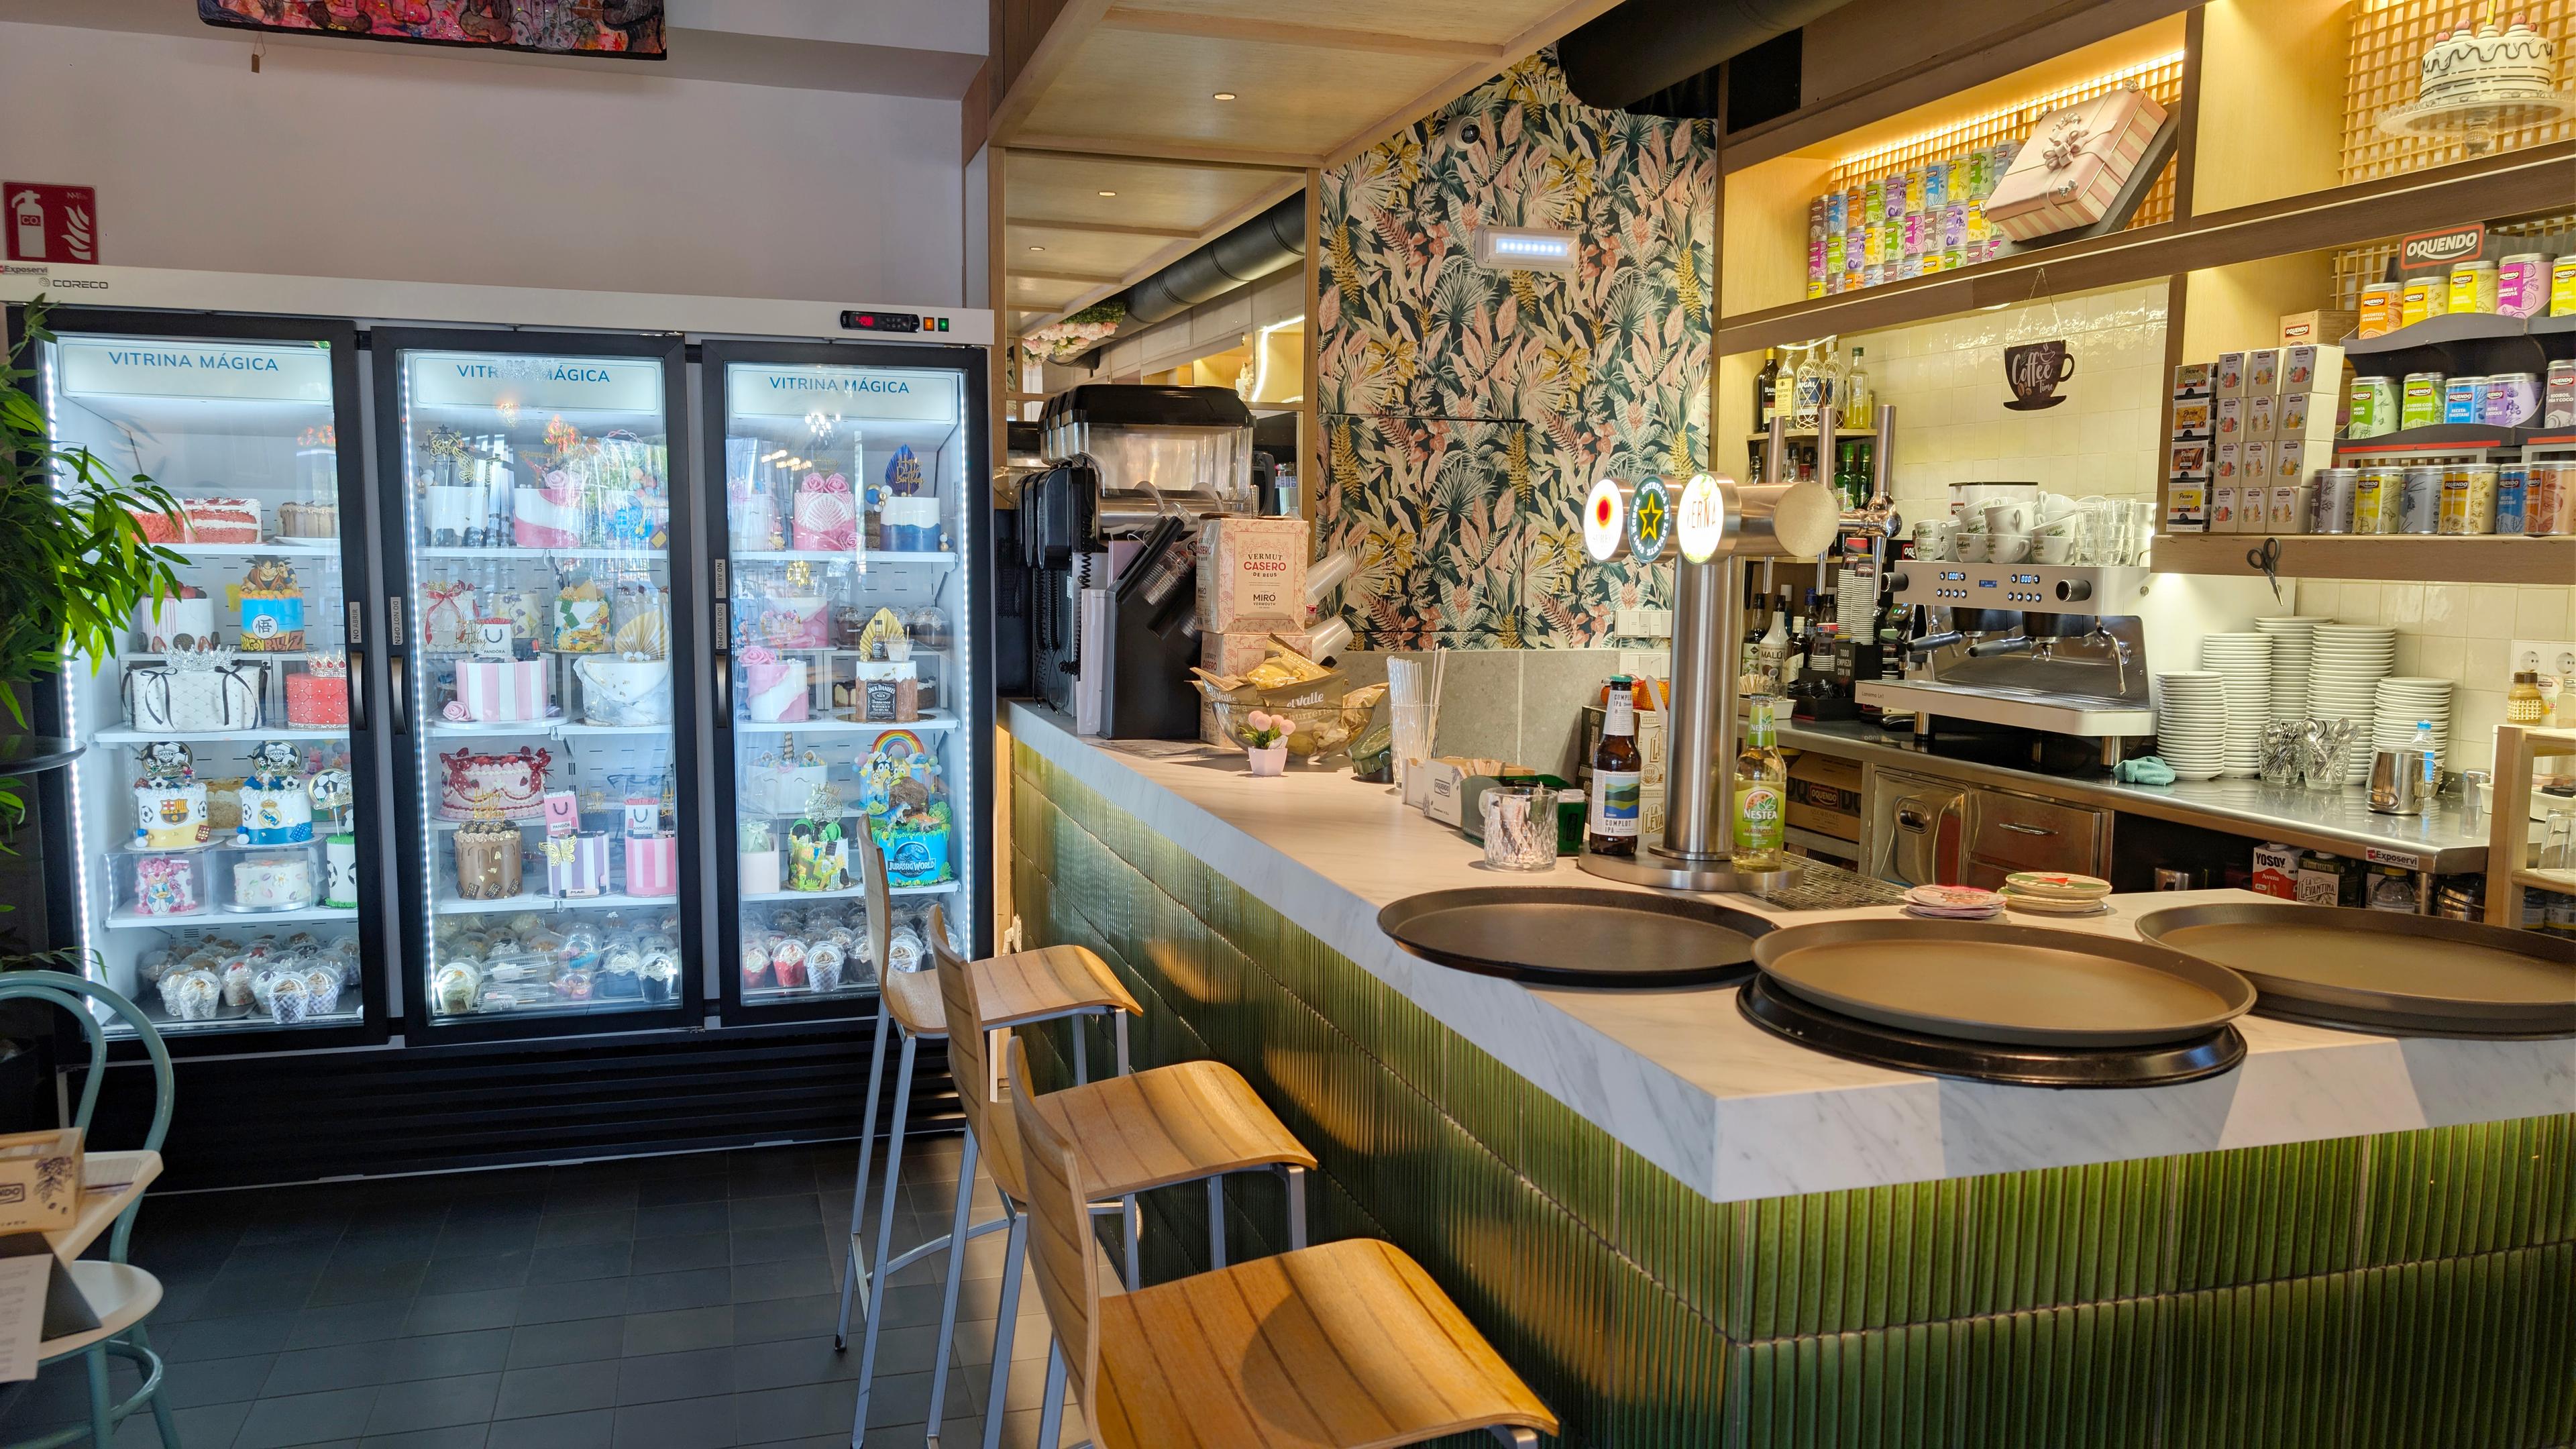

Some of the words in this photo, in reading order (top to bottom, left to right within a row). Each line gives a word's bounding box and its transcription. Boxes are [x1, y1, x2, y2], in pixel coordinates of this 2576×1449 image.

[2406, 232, 2477, 259] OQUENDO
[5, 266, 48, 274] Exposervi
[53, 280, 109, 289] CORECO
[2363, 298, 2384, 306] OQUENDO
[2286, 325, 2309, 335] OQUENDO
[108, 351, 193, 368] VITRINA
[200, 352, 279, 372] MÁGICA
[2012, 352, 2053, 387] Coffee
[769, 377, 839, 391] VITRINA
[844, 377, 910, 394] MÁGICA
[2035, 379, 2054, 394] Time
[2551, 377, 2573, 386] OQUENDO
[2408, 388, 2431, 396] OQUENDO
[2449, 393, 2472, 402] OQUENDO
[2445, 481, 2468, 489] OQUENDO
[1641, 481, 1668, 507] ESTRELLA
[1646, 522, 1669, 557] LEVANTE
[1248, 553, 1283, 561] VERMUT
[716, 562, 722, 572] NO
[1243, 561, 1287, 572] CASERO
[1253, 592, 1276, 602] MIRÓ
[392, 600, 399, 610] DO
[717, 606, 722, 616] DO
[256, 618, 272, 633] 悟
[353, 629, 360, 639] NO
[1761, 649, 1783, 659] MALÚ
[1839, 649, 1849, 657] TODO
[1837, 658, 1852, 667] EMPIEZA
[1295, 691, 1324, 706] Valle
[1811, 789, 1837, 802] OQUENDO
[1744, 809, 1777, 820] NESTEA
[1605, 820, 1631, 828] COMPLOT
[2255, 852, 2286, 869] YOSOY
[2375, 850, 2418, 866] Exposervi
[888, 861, 914, 871] JURASSIC
[913, 860, 935, 871] WORLD
[2261, 873, 2279, 882] Avena
[2300, 880, 2334, 898] LEVANTINA
